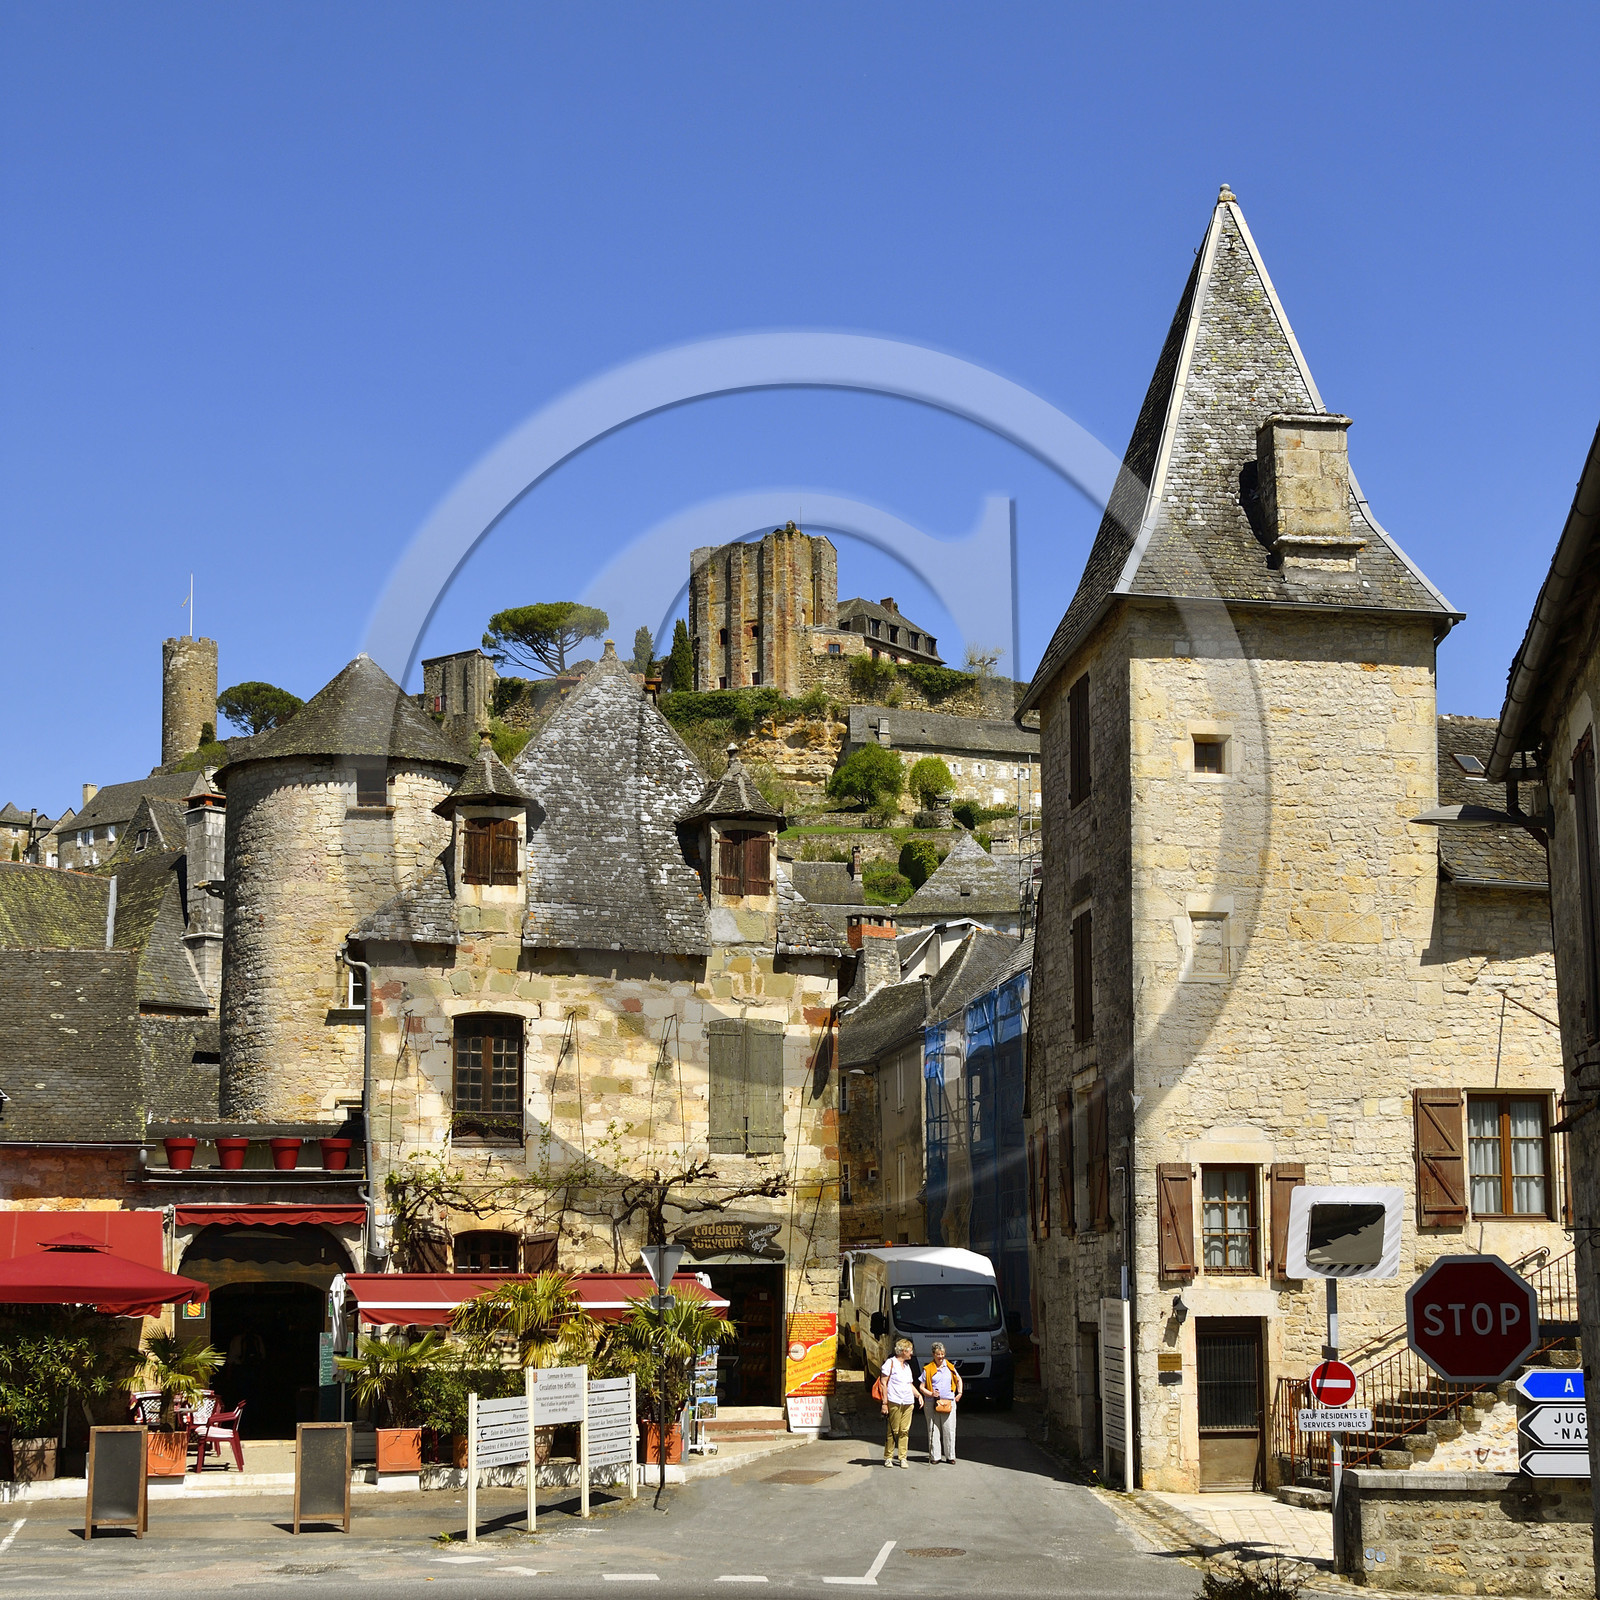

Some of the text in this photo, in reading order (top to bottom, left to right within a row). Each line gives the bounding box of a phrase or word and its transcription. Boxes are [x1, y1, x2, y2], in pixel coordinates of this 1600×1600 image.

[694, 1223, 744, 1236] Cadeaux
[691, 1236, 744, 1249] Souvenirs
[1423, 1302, 1521, 1337] STOP
[1564, 1378, 1575, 1393] A
[1300, 1412, 1318, 1420] SAUF
[1320, 1411, 1358, 1420] RÉSIDENTS
[1554, 1412, 1586, 1424] JUG
